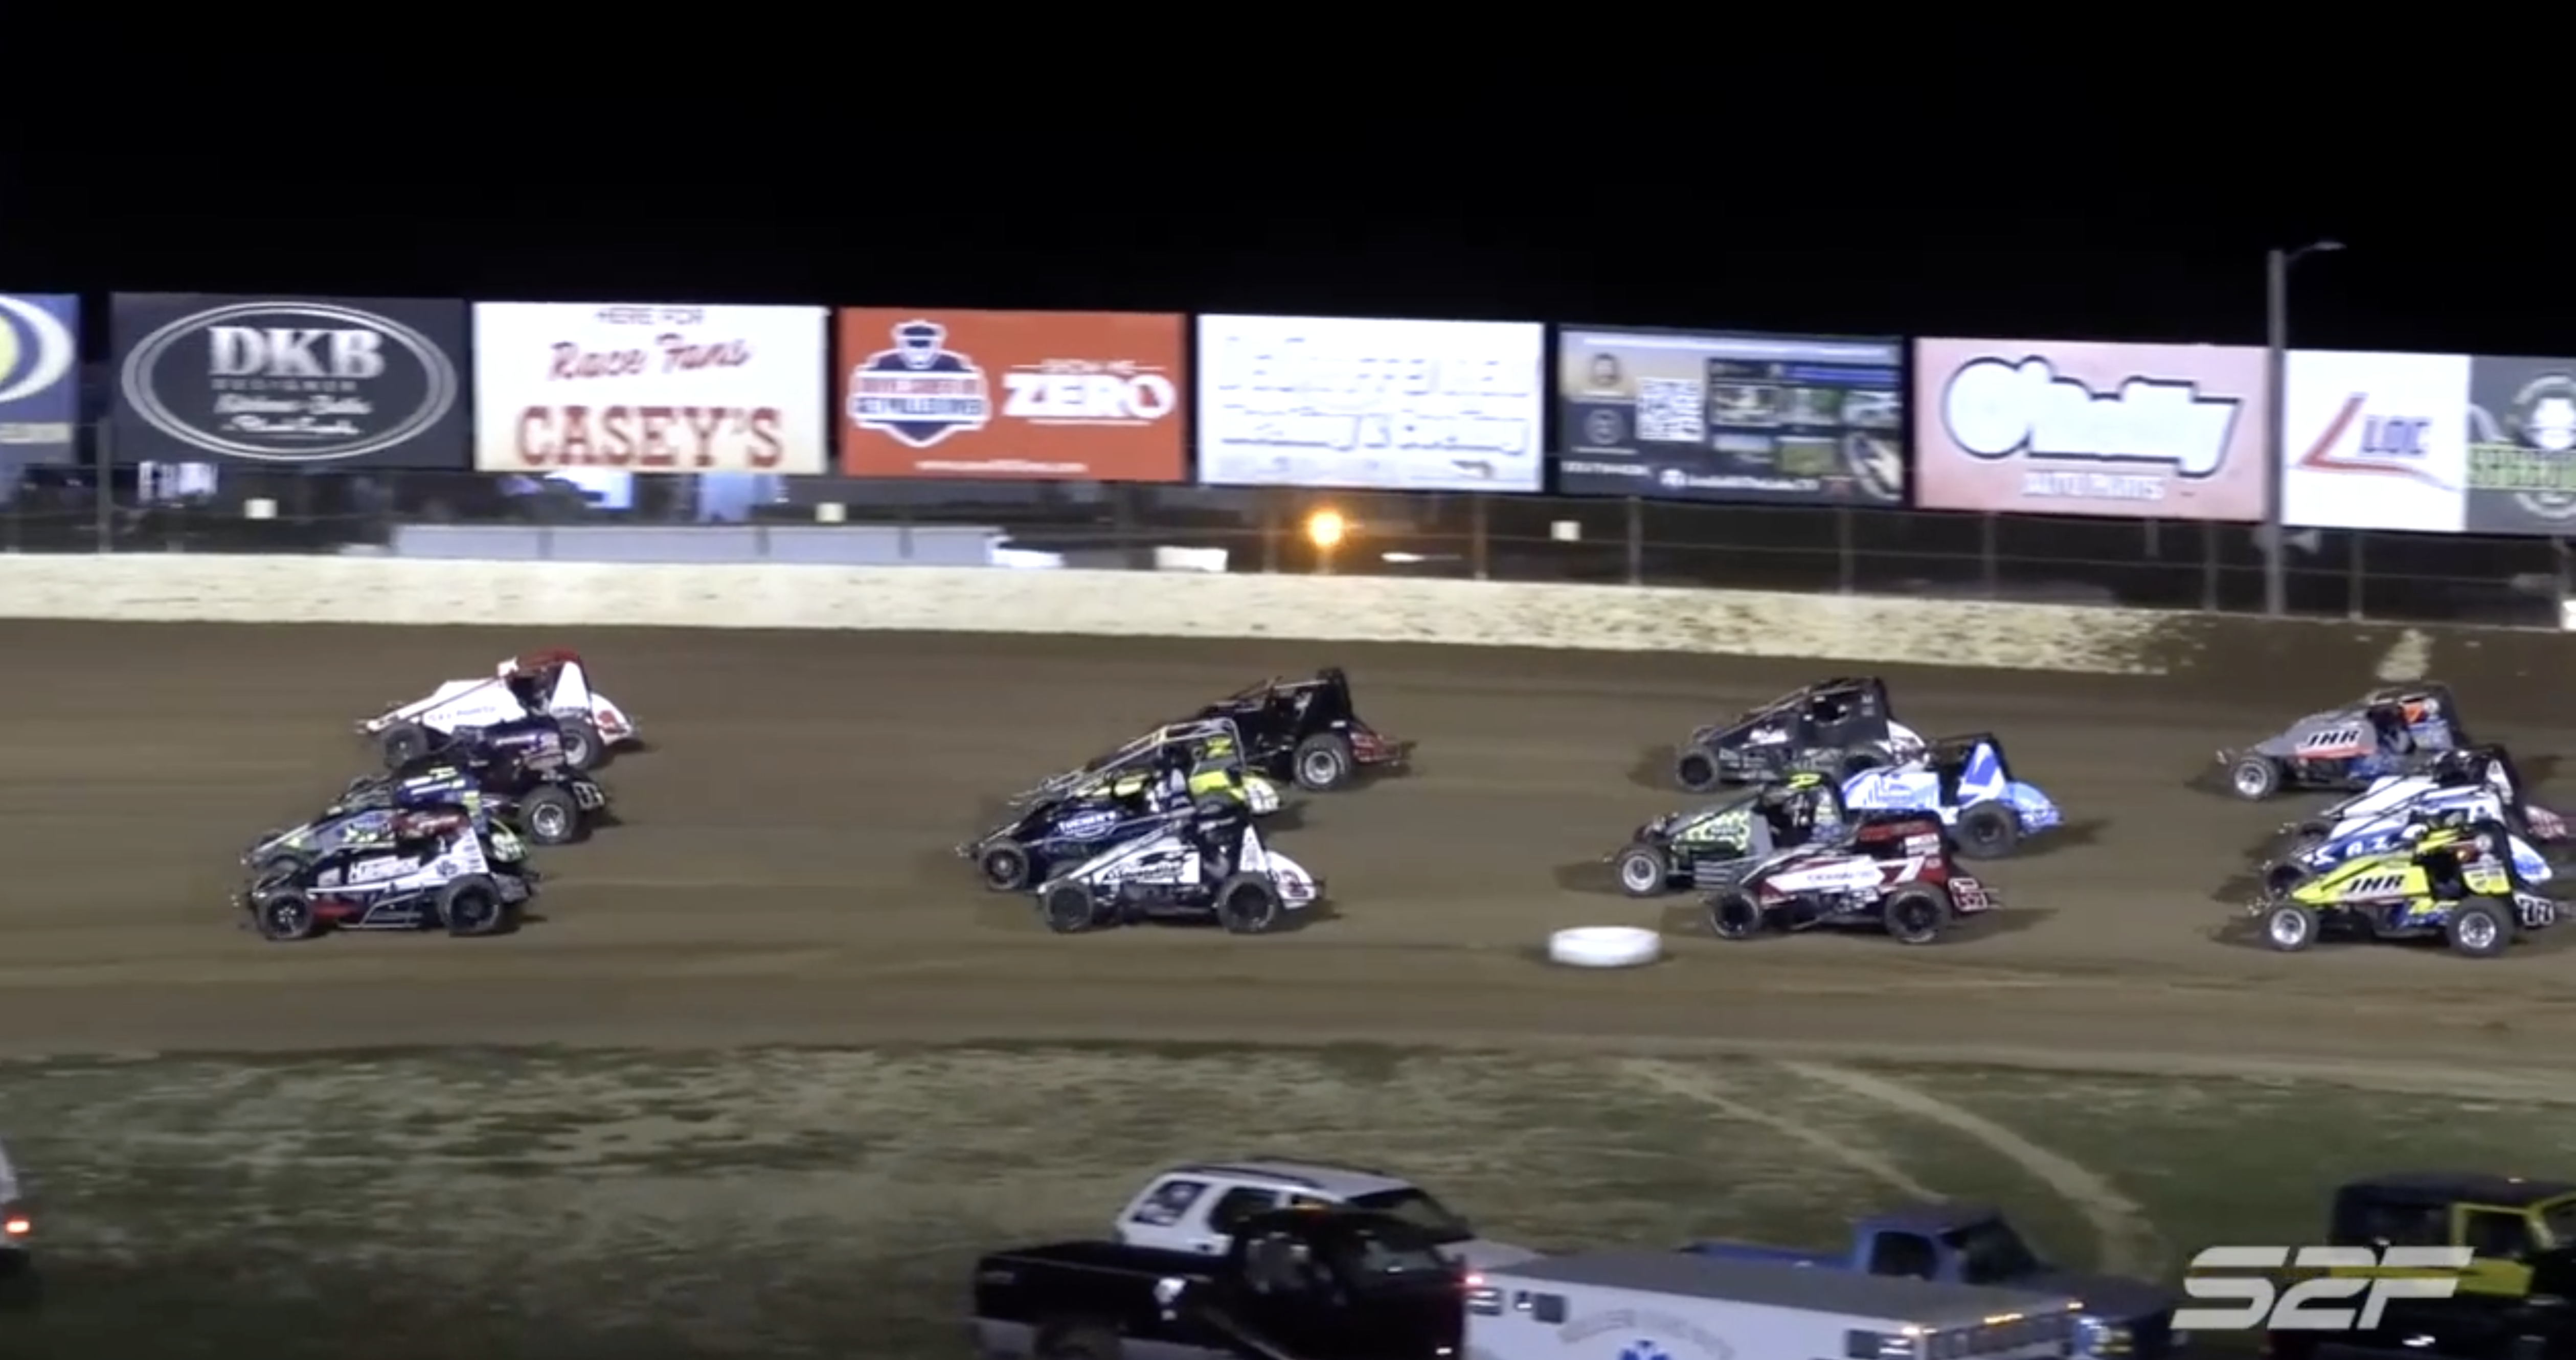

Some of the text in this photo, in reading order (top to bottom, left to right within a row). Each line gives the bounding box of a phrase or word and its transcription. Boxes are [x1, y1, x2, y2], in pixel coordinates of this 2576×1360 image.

[662, 308, 705, 325] FOR
[208, 325, 386, 379] DKB
[549, 332, 753, 380] Race Fans
[1002, 372, 1176, 419] ZERO
[516, 405, 784, 468] CASEY'S
[2359, 415, 2430, 457] LOC
